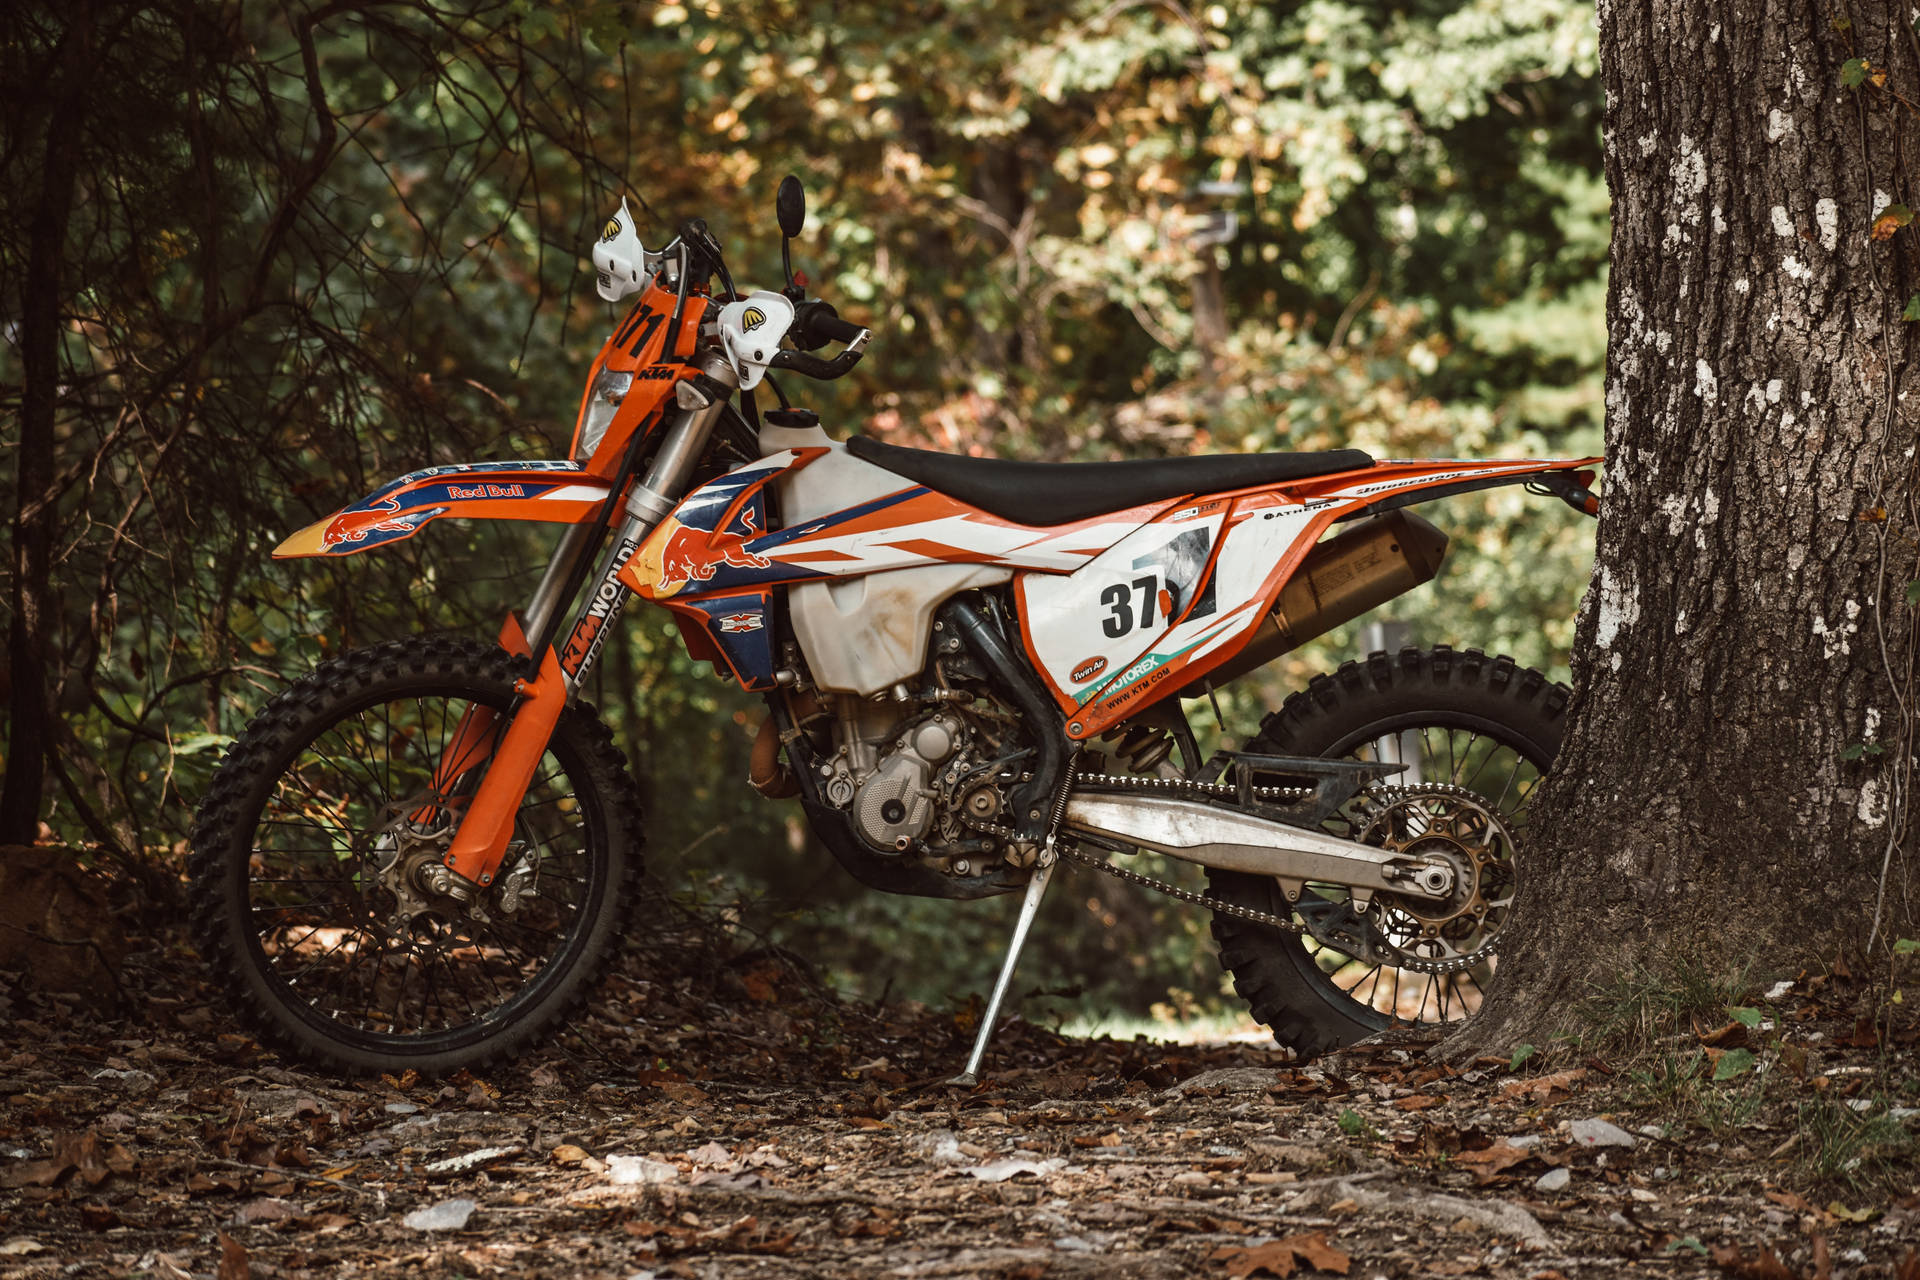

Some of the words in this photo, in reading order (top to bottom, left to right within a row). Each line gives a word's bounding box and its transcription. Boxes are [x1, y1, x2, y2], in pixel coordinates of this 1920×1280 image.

[637, 366, 676, 381] KTM
[447, 486, 485, 499] Red
[488, 484, 525, 498] Bull
[1275, 503, 1332, 518] ATHENA
[1073, 666, 1093, 682] Twin
[1093, 659, 1105, 671] Air
[1106, 667, 1170, 710] WWW.KTM.COM
